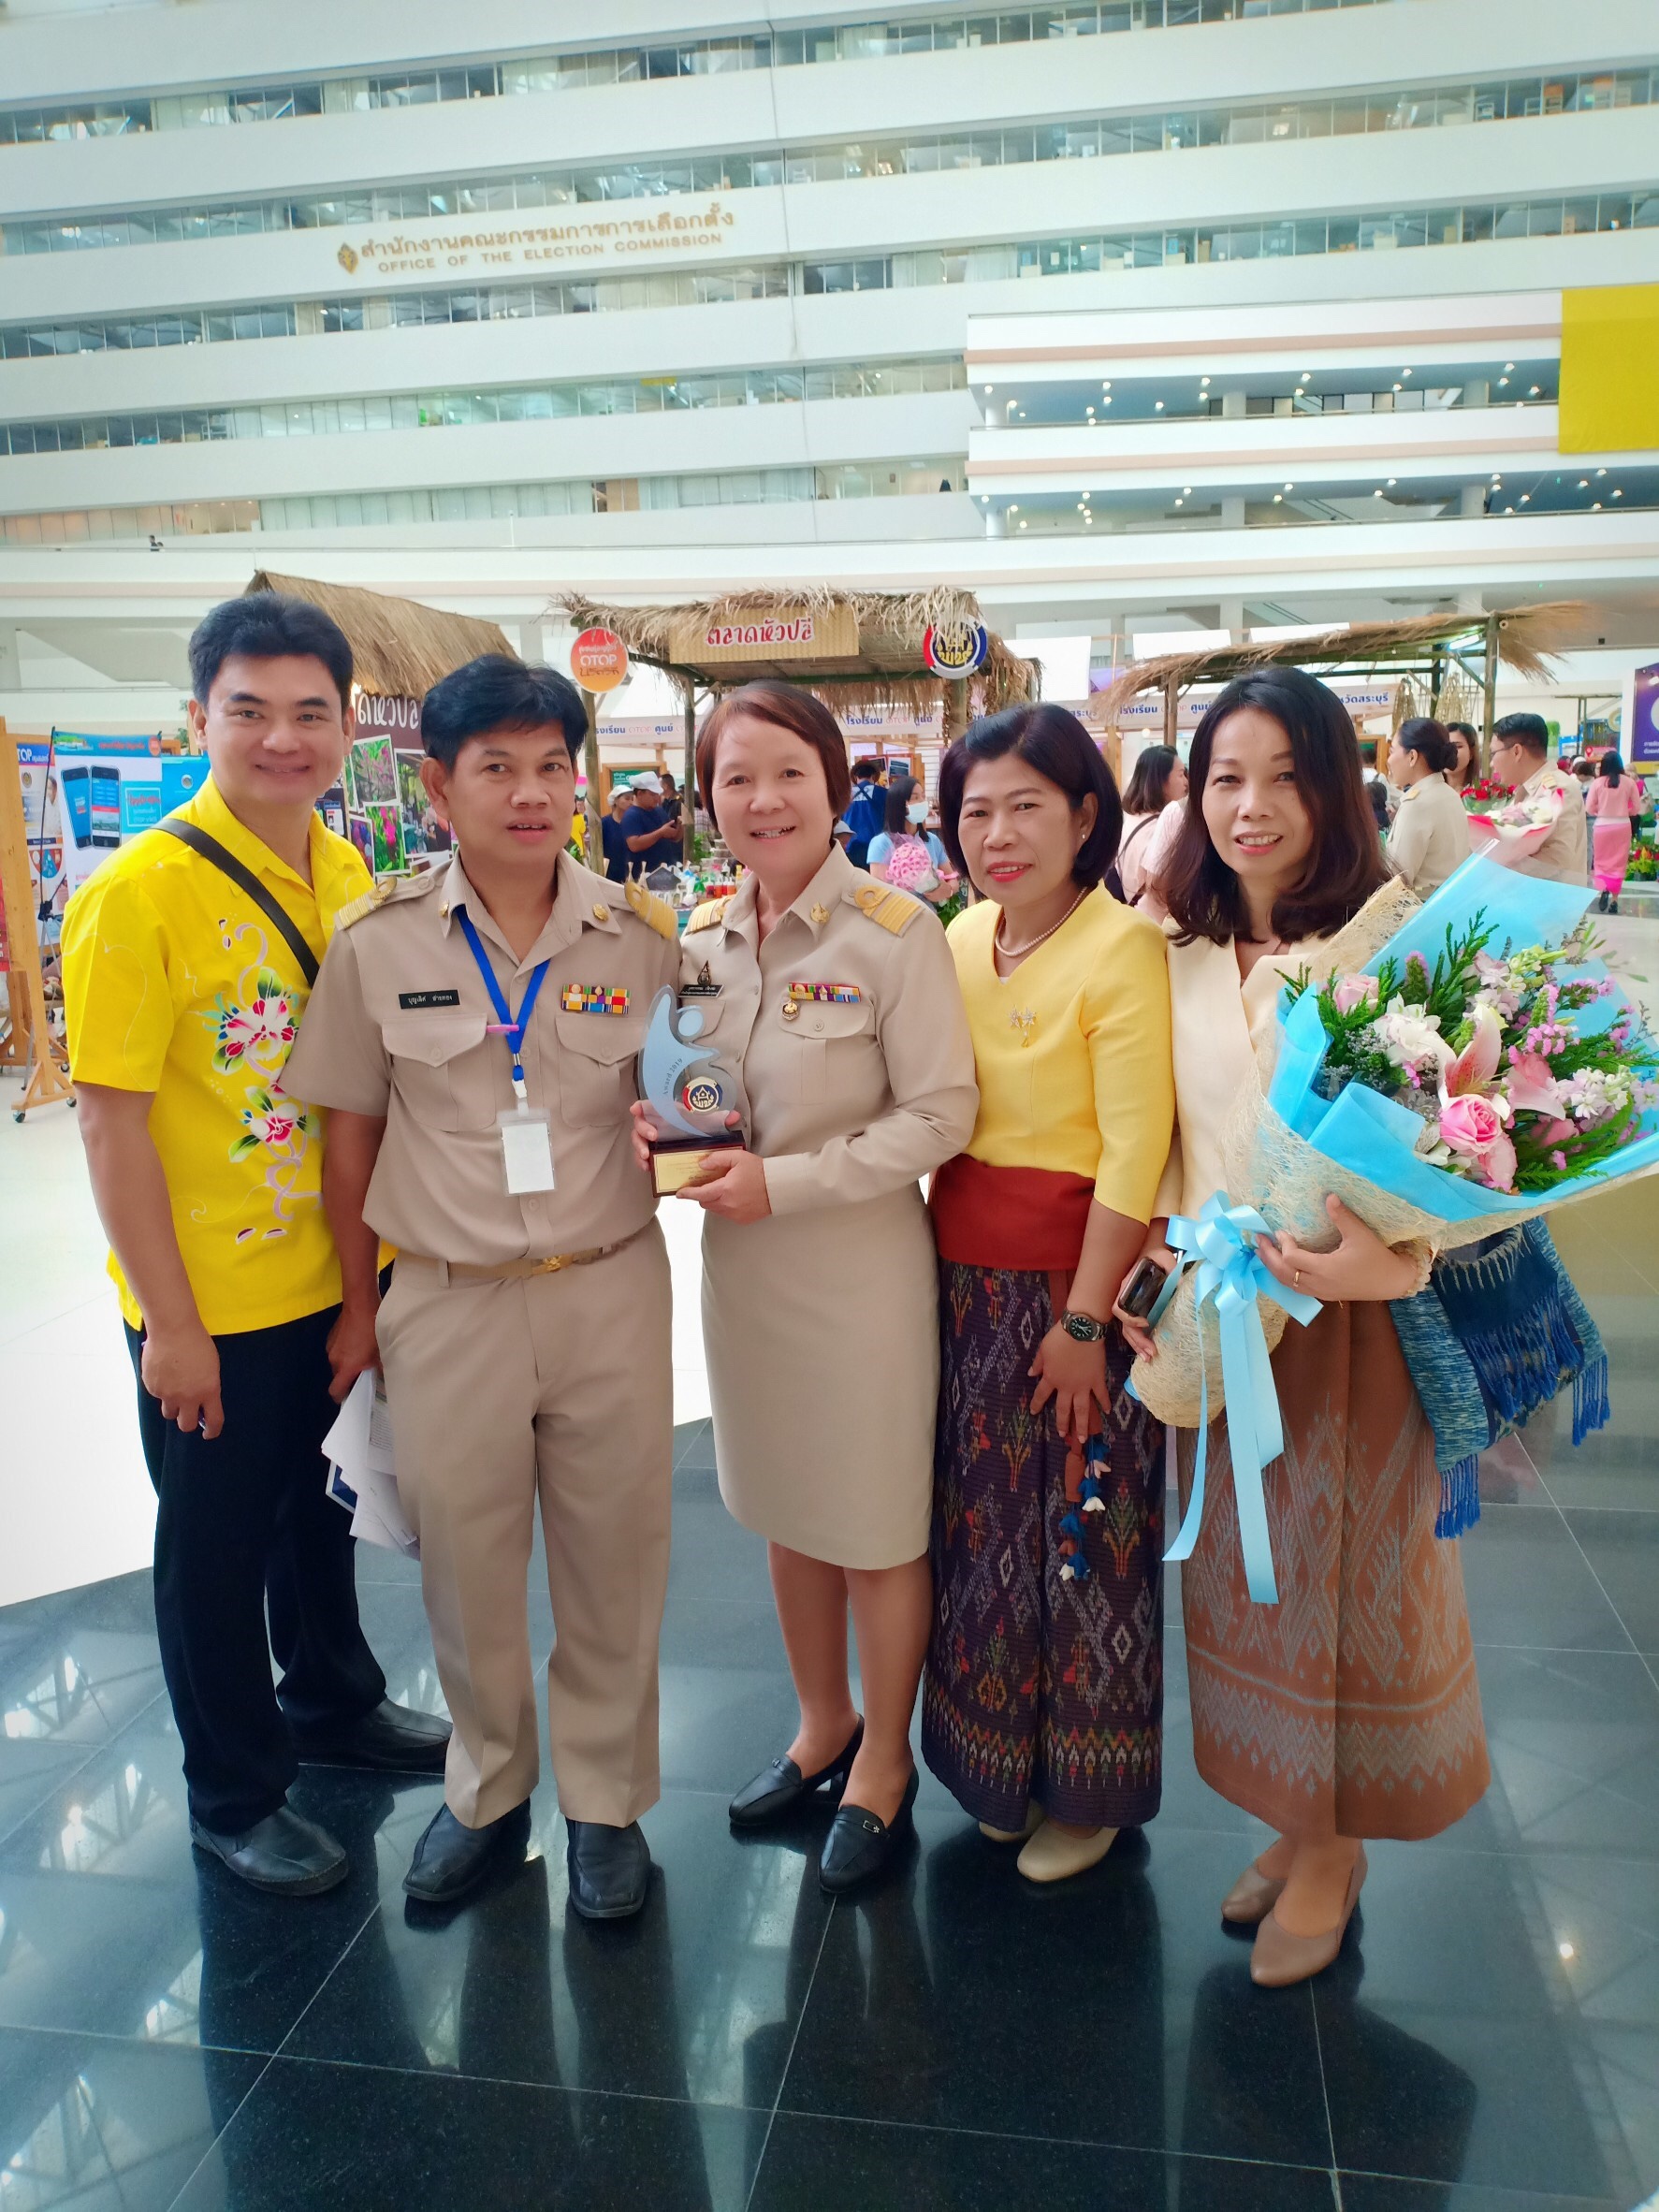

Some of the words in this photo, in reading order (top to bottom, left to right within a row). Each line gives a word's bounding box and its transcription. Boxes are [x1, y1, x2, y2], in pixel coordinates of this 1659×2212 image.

[360, 201, 735, 258] สำนักงานคณะกรรมการการเลือกตั้ง
[378, 257, 436, 273] OFFICE
[447, 255, 470, 268] OF
[481, 251, 513, 264] THE
[523, 243, 604, 260] ELECTION
[614, 233, 722, 253] COMMISSION
[580, 654, 618, 666] OTOP
[595, 725, 626, 735] รงเรียน
[628, 725, 651, 734] OTOP
[654, 722, 674, 735] ศูนย์
[662, 1072, 673, 1095] Award
[669, 1057, 683, 1073] 2019
